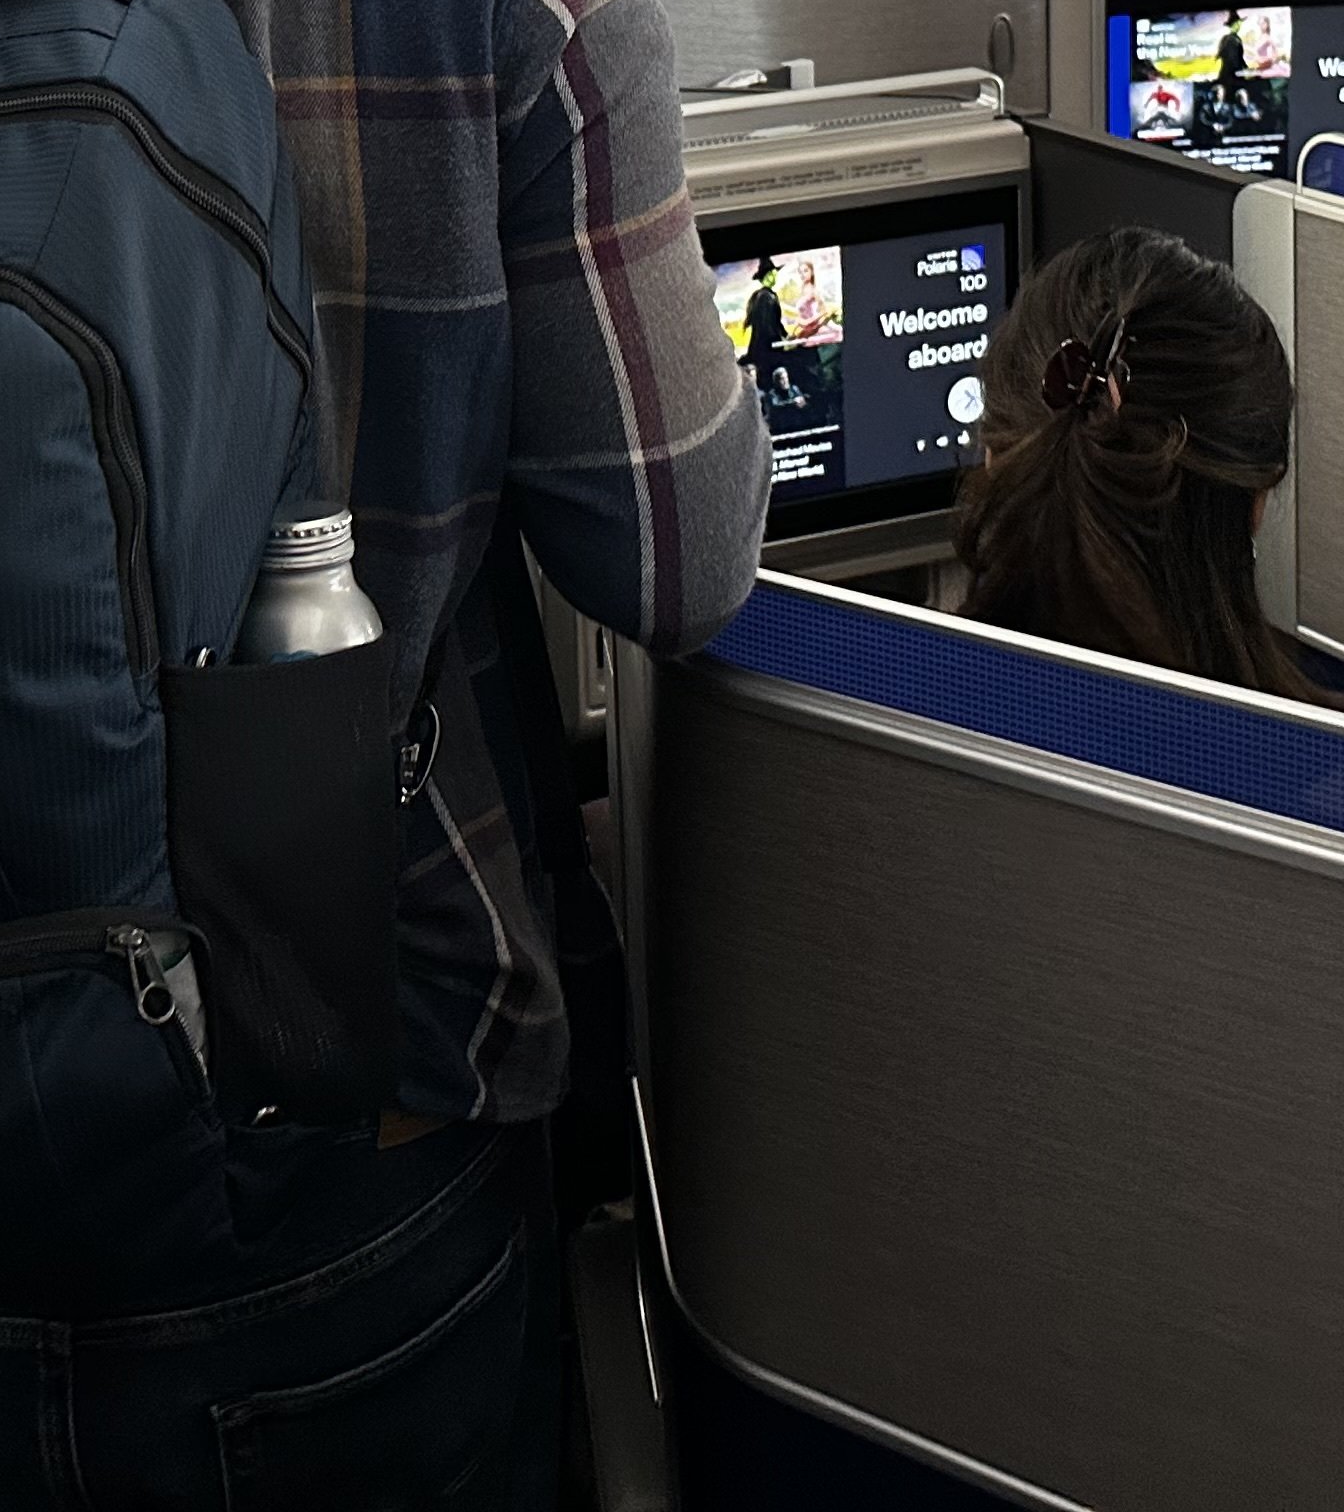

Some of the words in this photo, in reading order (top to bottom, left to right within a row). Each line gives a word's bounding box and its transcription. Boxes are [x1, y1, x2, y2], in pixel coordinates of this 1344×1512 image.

[959, 273, 988, 292] 10D
[879, 303, 988, 338] Welcome
[908, 333, 988, 370] aboard
